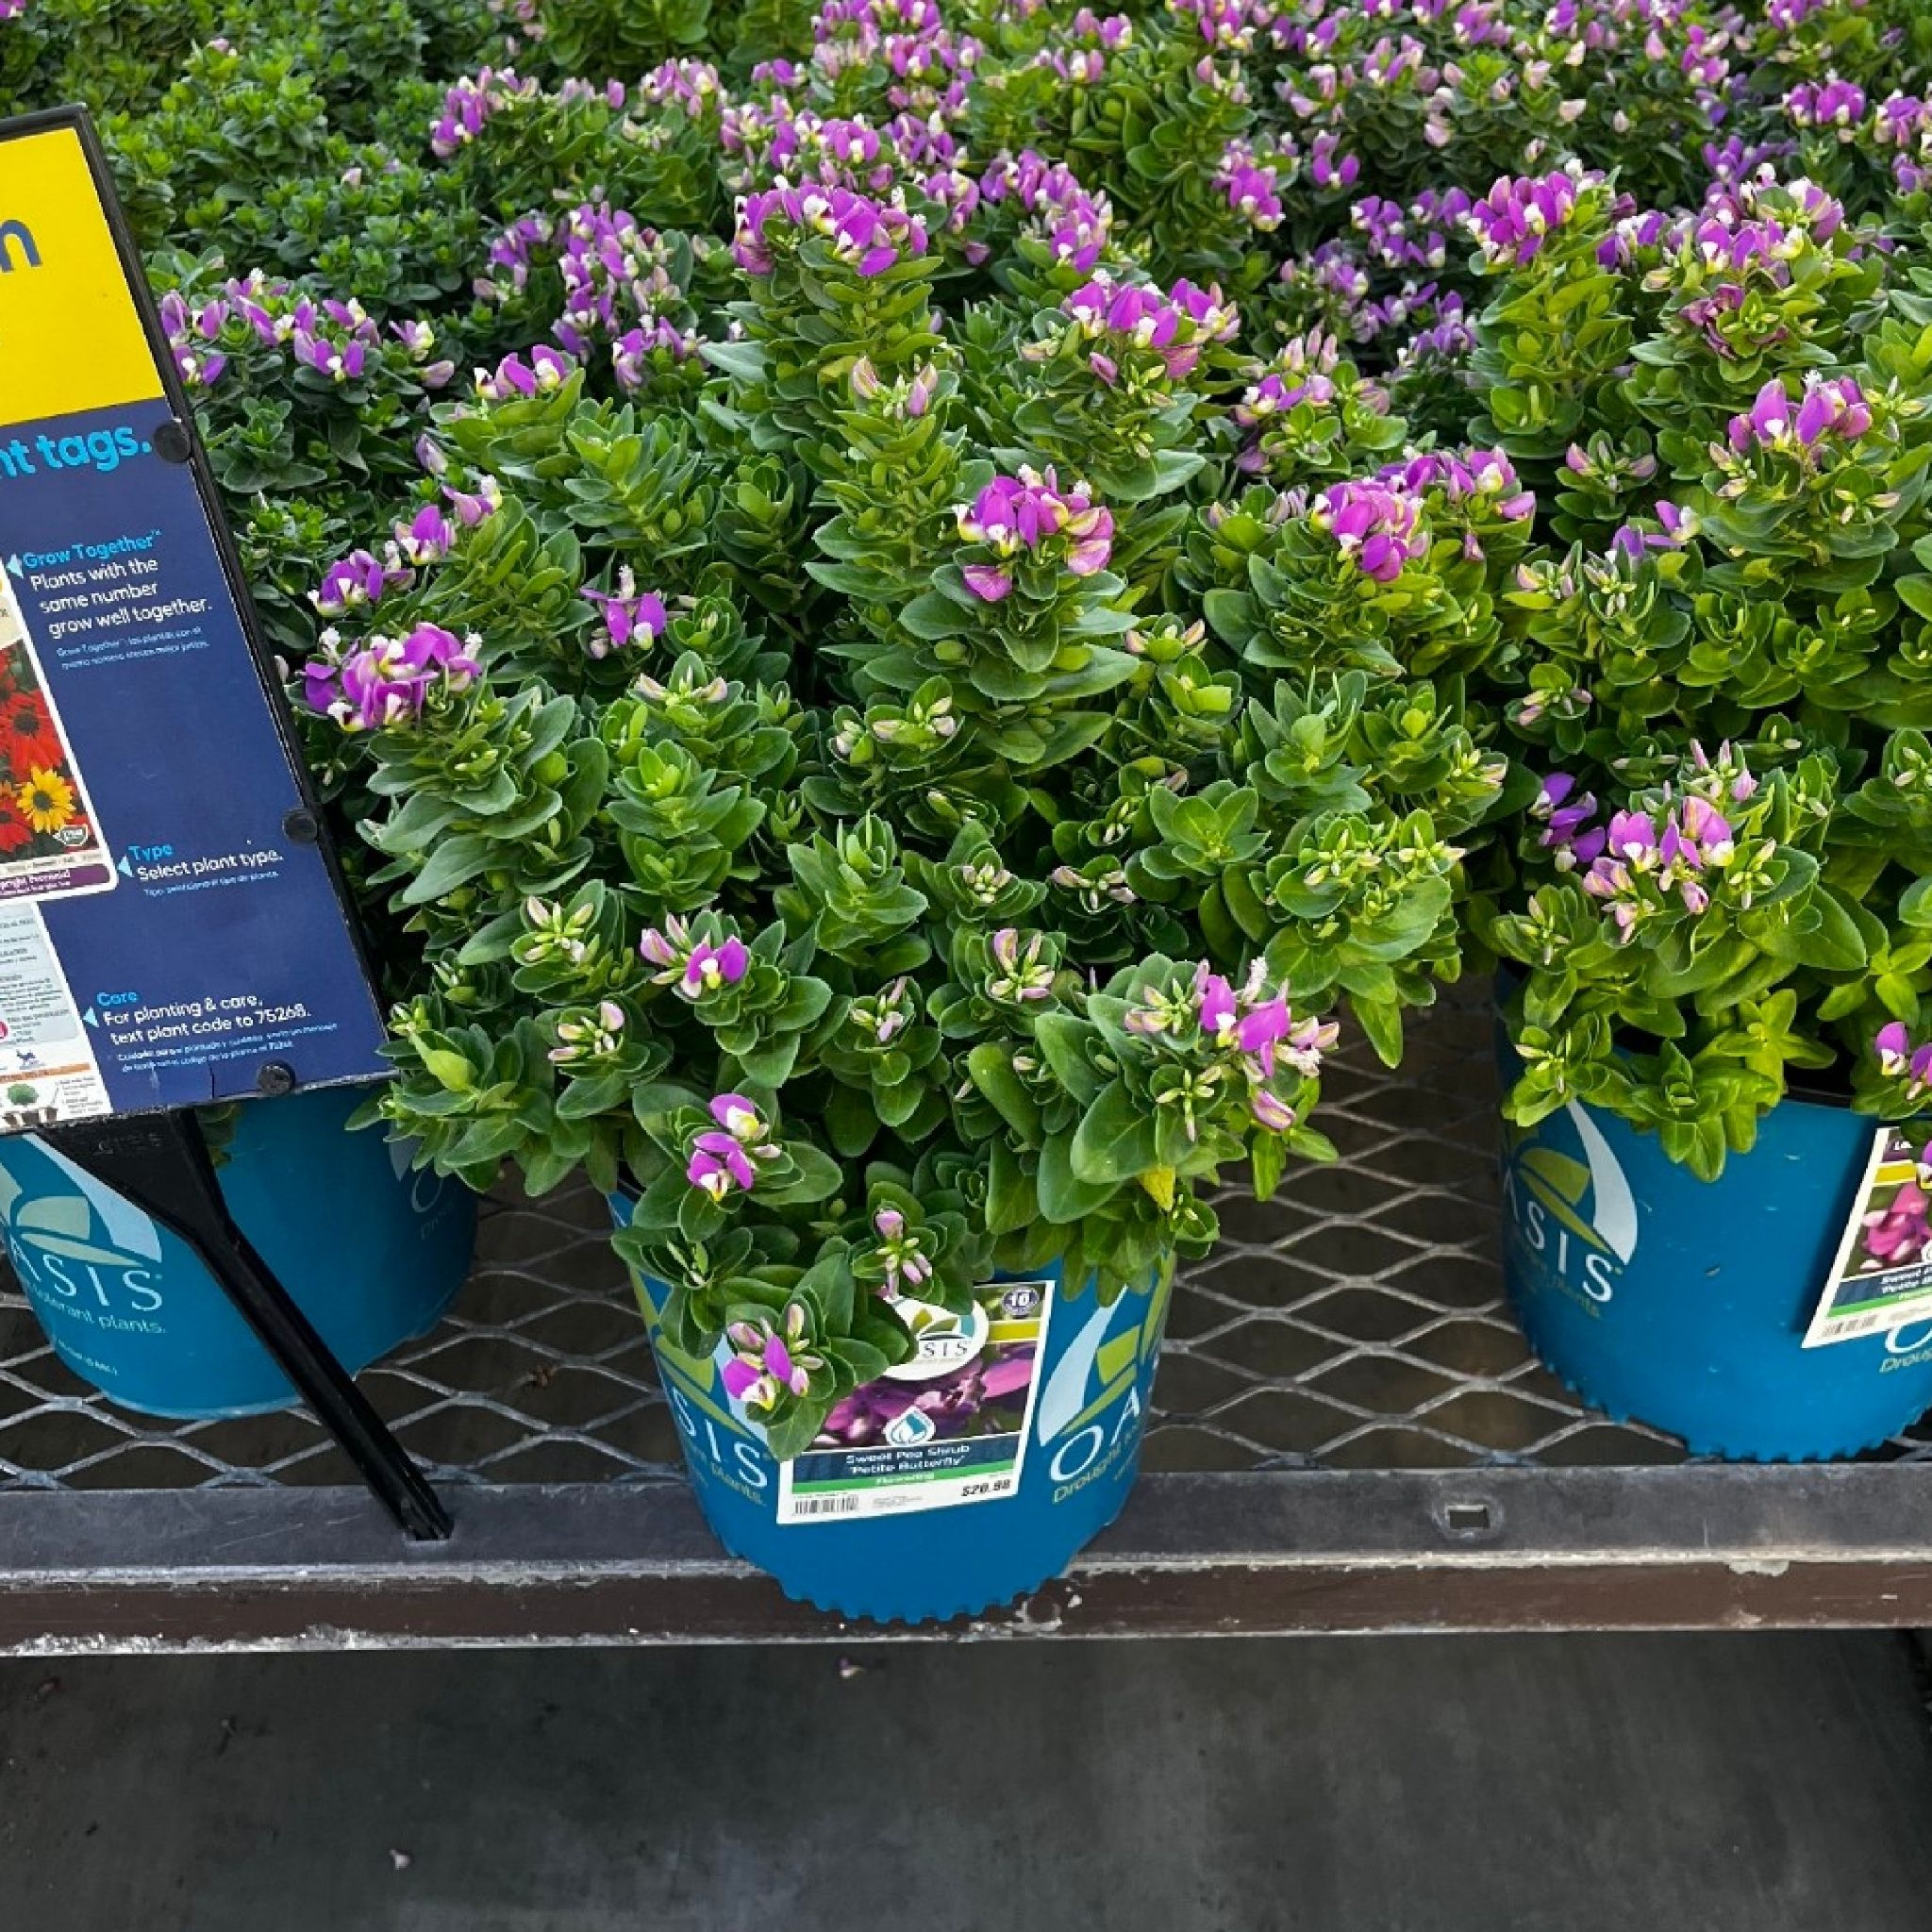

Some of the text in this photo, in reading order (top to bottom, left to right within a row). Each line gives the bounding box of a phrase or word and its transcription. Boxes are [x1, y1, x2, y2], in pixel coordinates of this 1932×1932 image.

[35, 426, 153, 473] tags.
[23, 550, 71, 569] Grow
[29, 558, 158, 591] Plants with the
[40, 583, 158, 613] same number
[49, 598, 213, 640] grow well together.
[128, 843, 175, 861] Type
[137, 849, 284, 881] Select plant type.
[96, 991, 138, 1006] Care
[103, 1011, 129, 1026] For
[134, 1002, 203, 1024] planting
[204, 997, 217, 1012] &
[109, 1030, 145, 1045] text
[147, 1024, 190, 1042] plant
[192, 1017, 232, 1034] code
[235, 1016, 254, 1027] to
[255, 1003, 311, 1024] 75268.
[98, 1314, 166, 1334] plants.
[845, 1444, 970, 1464] Sweet Pea Shrub
